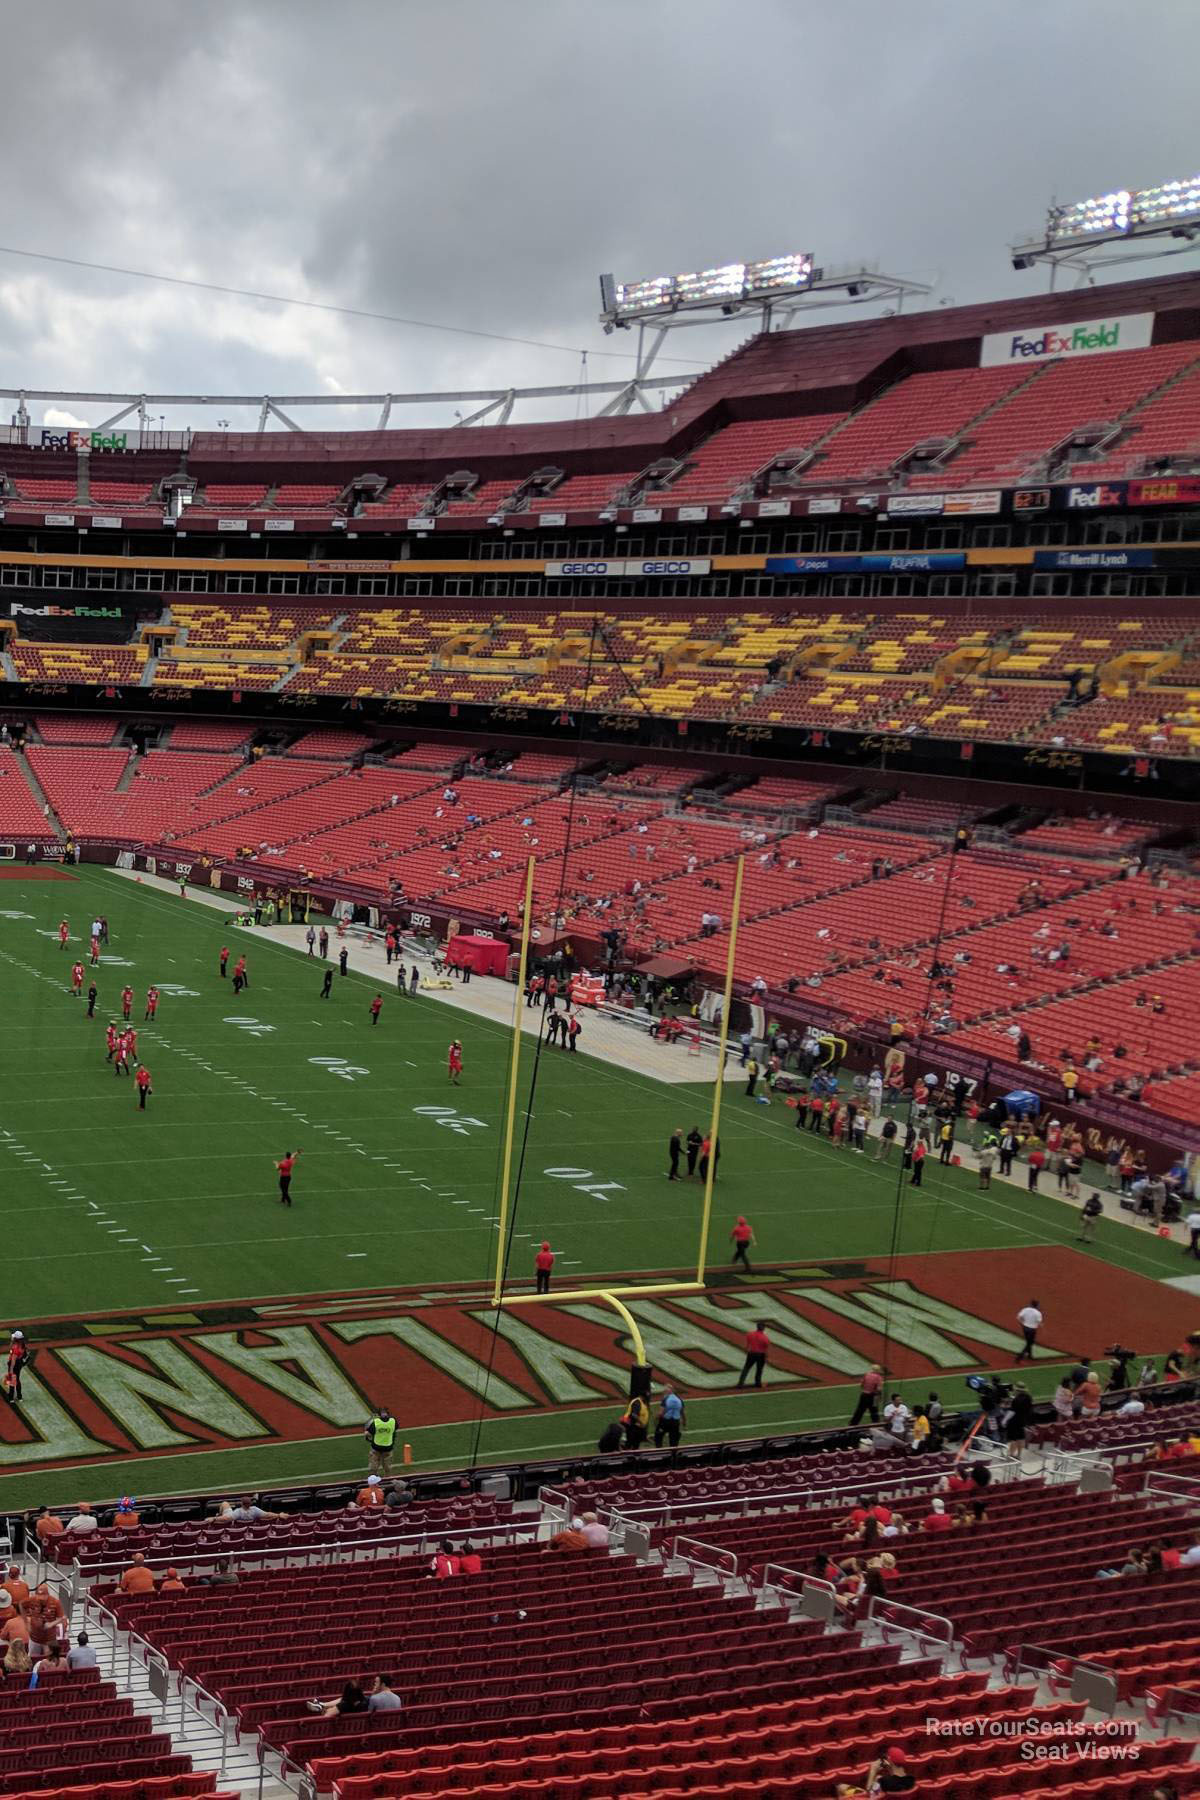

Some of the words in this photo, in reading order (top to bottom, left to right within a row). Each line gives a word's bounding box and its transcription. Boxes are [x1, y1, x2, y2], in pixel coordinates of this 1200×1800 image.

[1010, 322, 1120, 358] FedExField
[41, 430, 127, 449] FedExField
[1068, 485, 1121, 507] FedEx
[562, 562, 608, 574] GEICO
[642, 561, 691, 574] GEICO
[10, 602, 122, 618] FedExField
